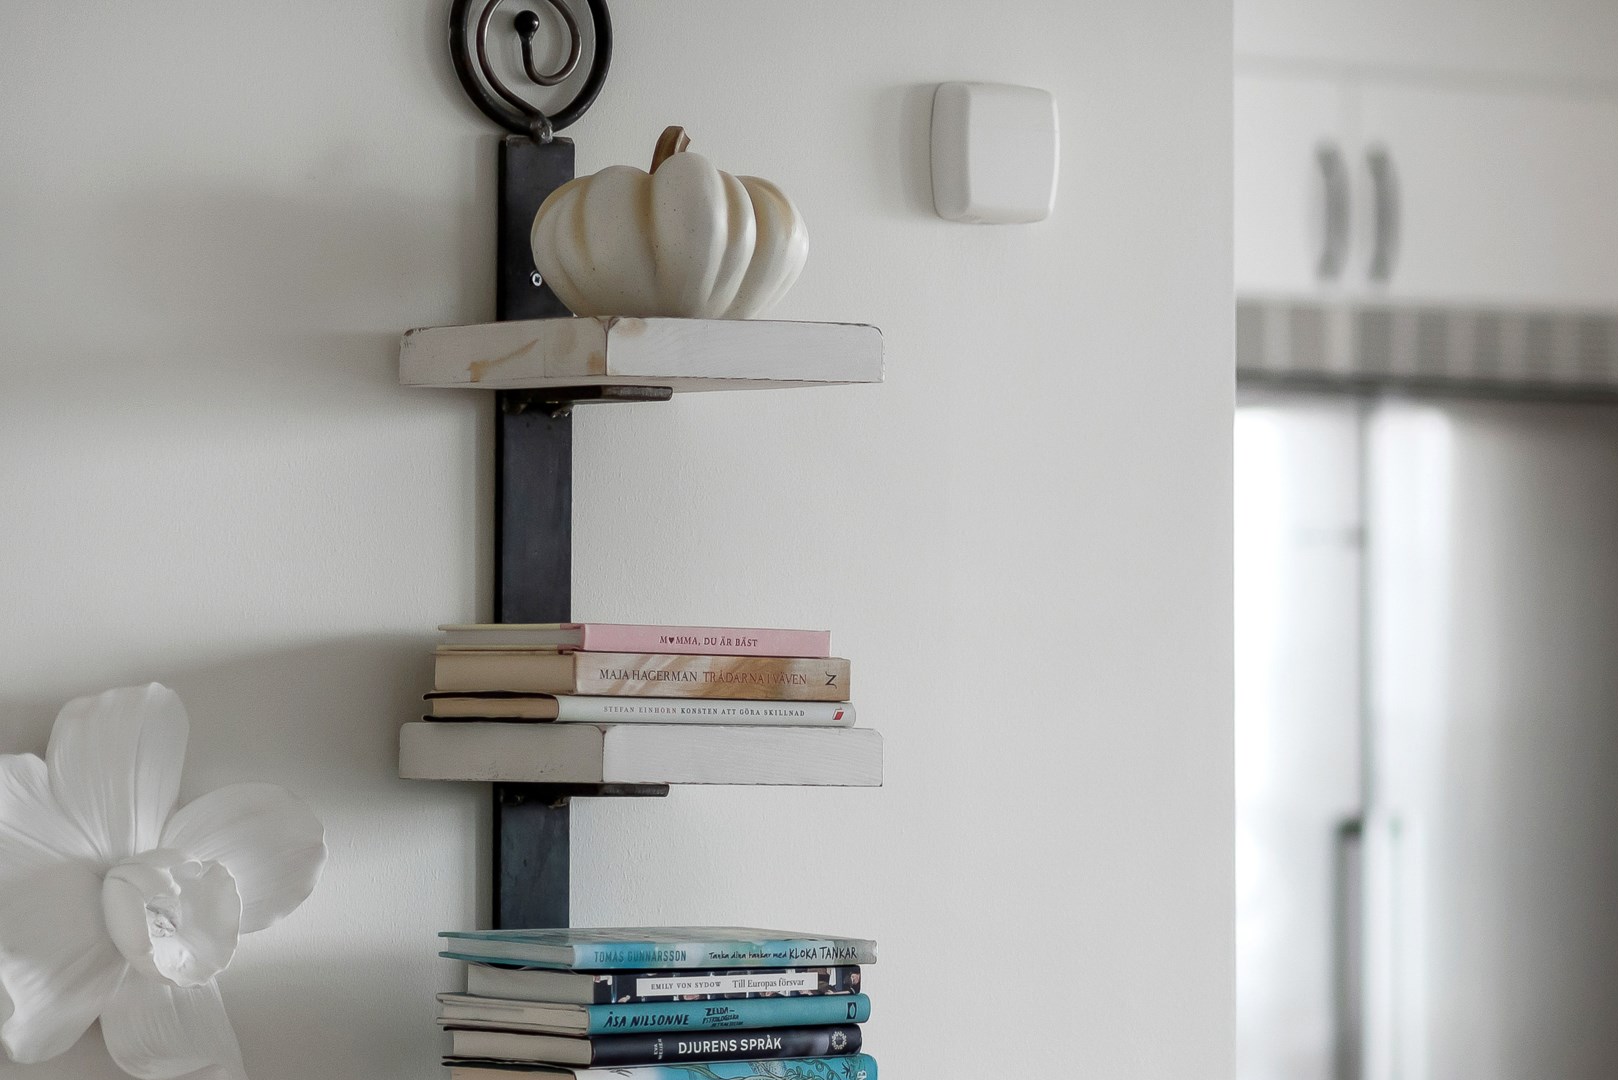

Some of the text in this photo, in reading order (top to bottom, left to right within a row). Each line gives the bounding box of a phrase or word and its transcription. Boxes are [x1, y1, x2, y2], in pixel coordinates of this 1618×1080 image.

[720, 636, 732, 646] ÄR
[735, 637, 758, 647] BÄST
[600, 669, 630, 681] MAJA
[632, 670, 697, 682] HAGERMAN
[703, 669, 764, 683] TRÅDARNA
[772, 672, 807, 685] VÄVEN
[739, 707, 760, 716] GÖRA
[763, 709, 805, 717] SKILLNAD
[594, 951, 624, 963] TOMAS
[627, 950, 687, 962] GUNNARSSON
[731, 951, 746, 959] dina
[749, 950, 771, 959] tankar
[772, 950, 787, 958] med
[789, 948, 817, 960] KLOKA
[819, 946, 857, 960] TANKAR
[732, 980, 746, 989] Till
[747, 979, 777, 990] Europas
[778, 977, 805, 987] försvar
[603, 1011, 690, 1028] ÅSA NILSONNE
[678, 1034, 782, 1054] DJURENS SPRÅK
